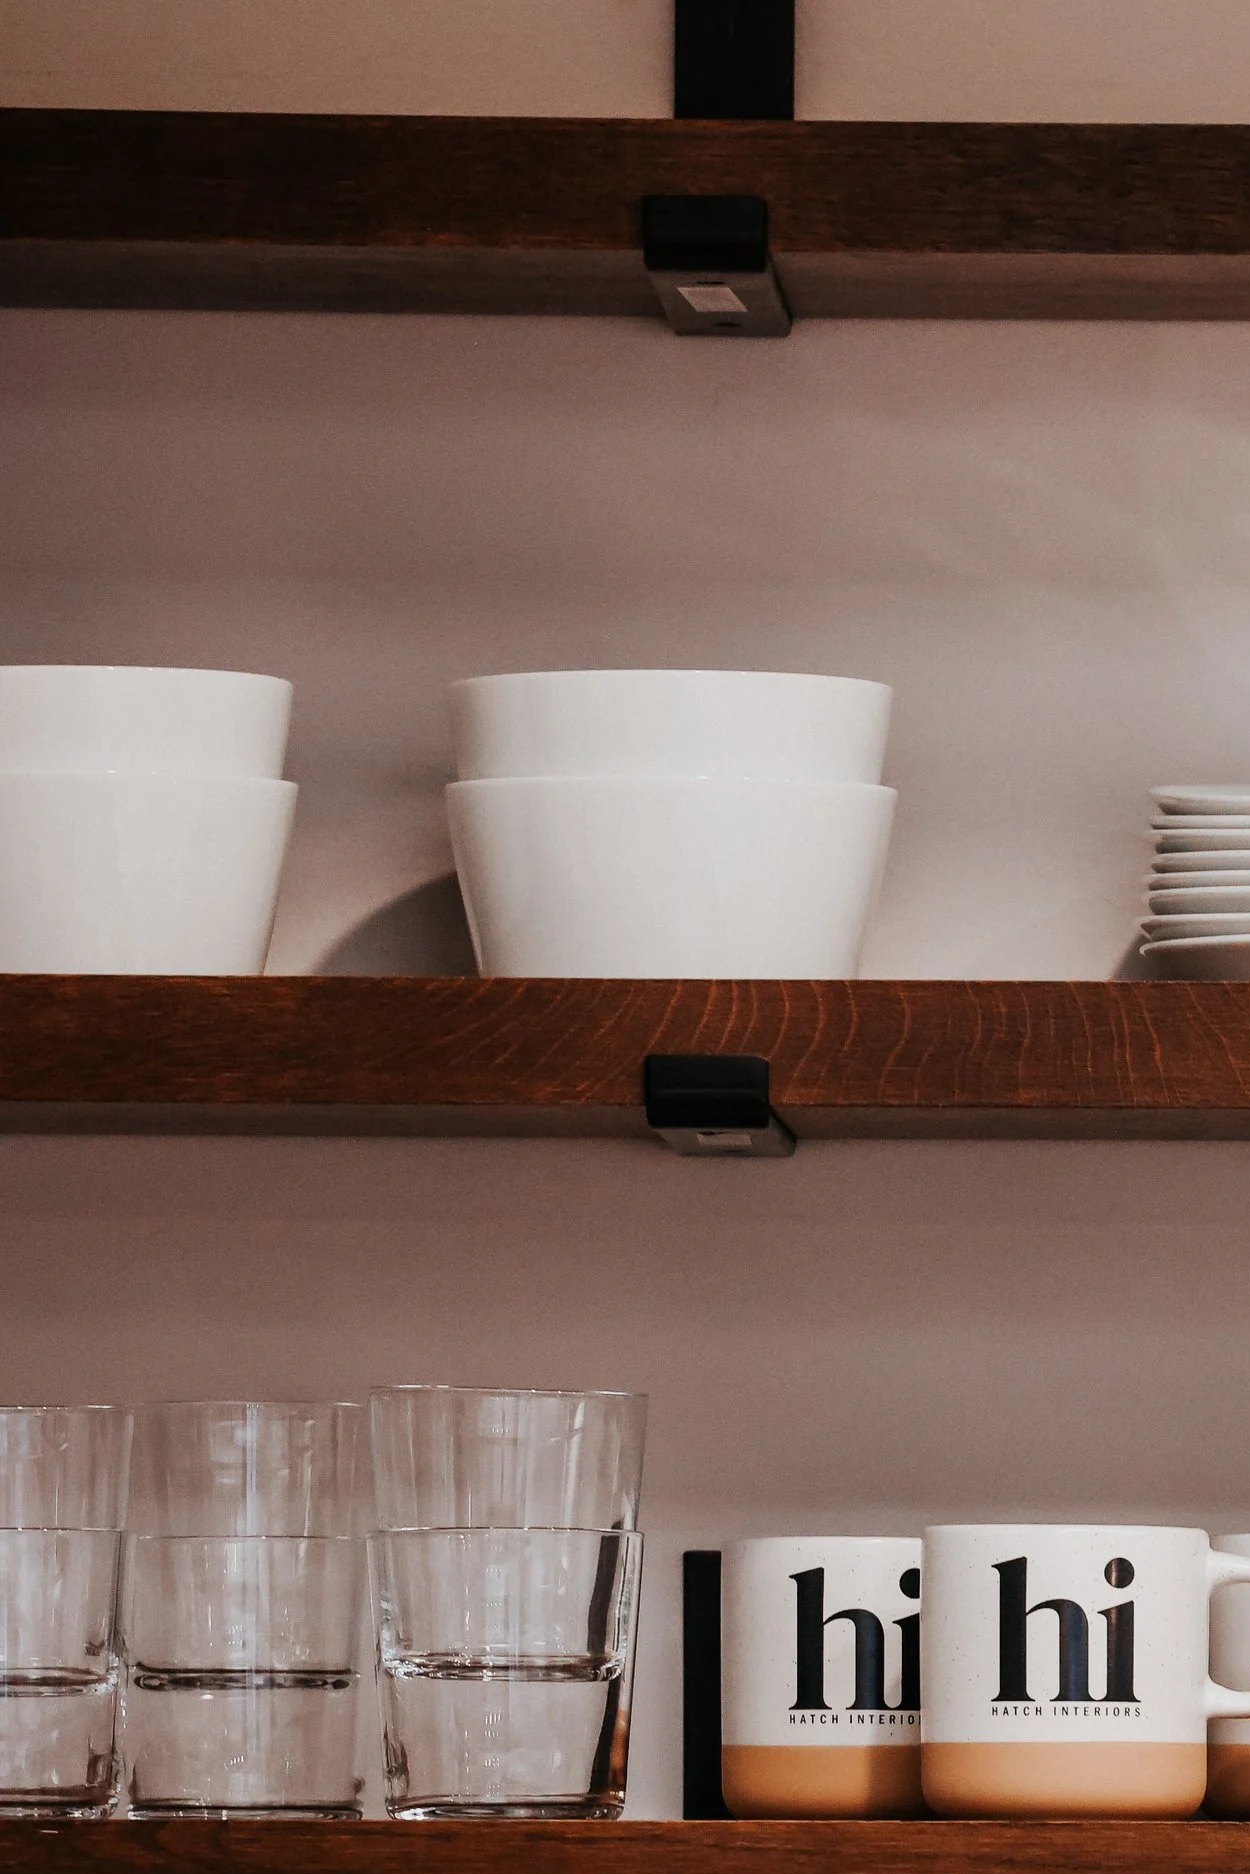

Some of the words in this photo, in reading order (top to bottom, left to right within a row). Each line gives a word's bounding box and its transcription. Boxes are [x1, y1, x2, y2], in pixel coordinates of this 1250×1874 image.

[789, 1567, 920, 1710] hi
[991, 1556, 1142, 1703] hi
[789, 1714, 839, 1725] HATCH
[849, 1714, 920, 1725] INTERIO
[991, 1706, 1043, 1717] HATCH
[1053, 1706, 1142, 1718] INTERIORS
